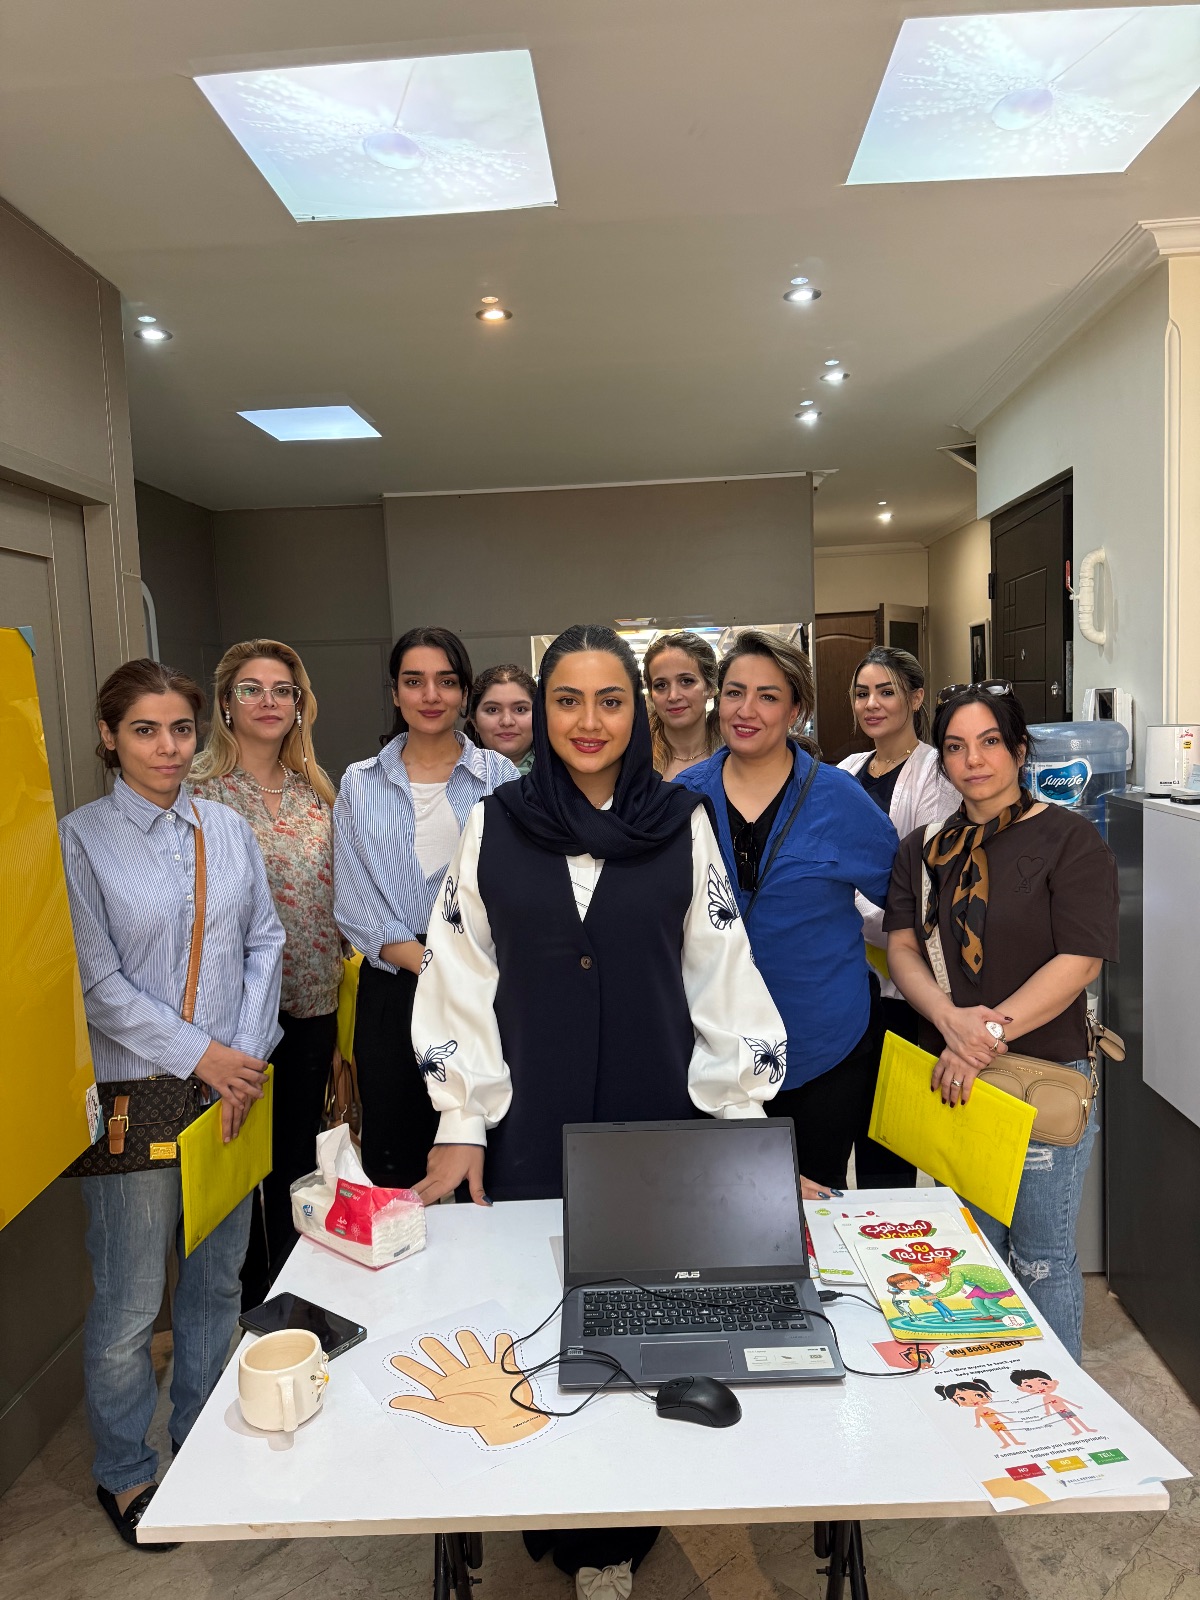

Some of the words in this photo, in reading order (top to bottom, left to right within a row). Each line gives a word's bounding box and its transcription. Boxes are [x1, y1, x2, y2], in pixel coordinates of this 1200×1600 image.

[1040, 774, 1084, 788] Surprise
[865, 1222, 896, 1234] خوب
[896, 1221, 928, 1232] لمس
[912, 1244, 929, 1253] نه
[918, 1250, 952, 1263] یعنی
[674, 1271, 701, 1280] ASUS
[949, 1348, 966, 1356] My
[966, 1344, 991, 1352] Body
[990, 1340, 1022, 1349] Safety
